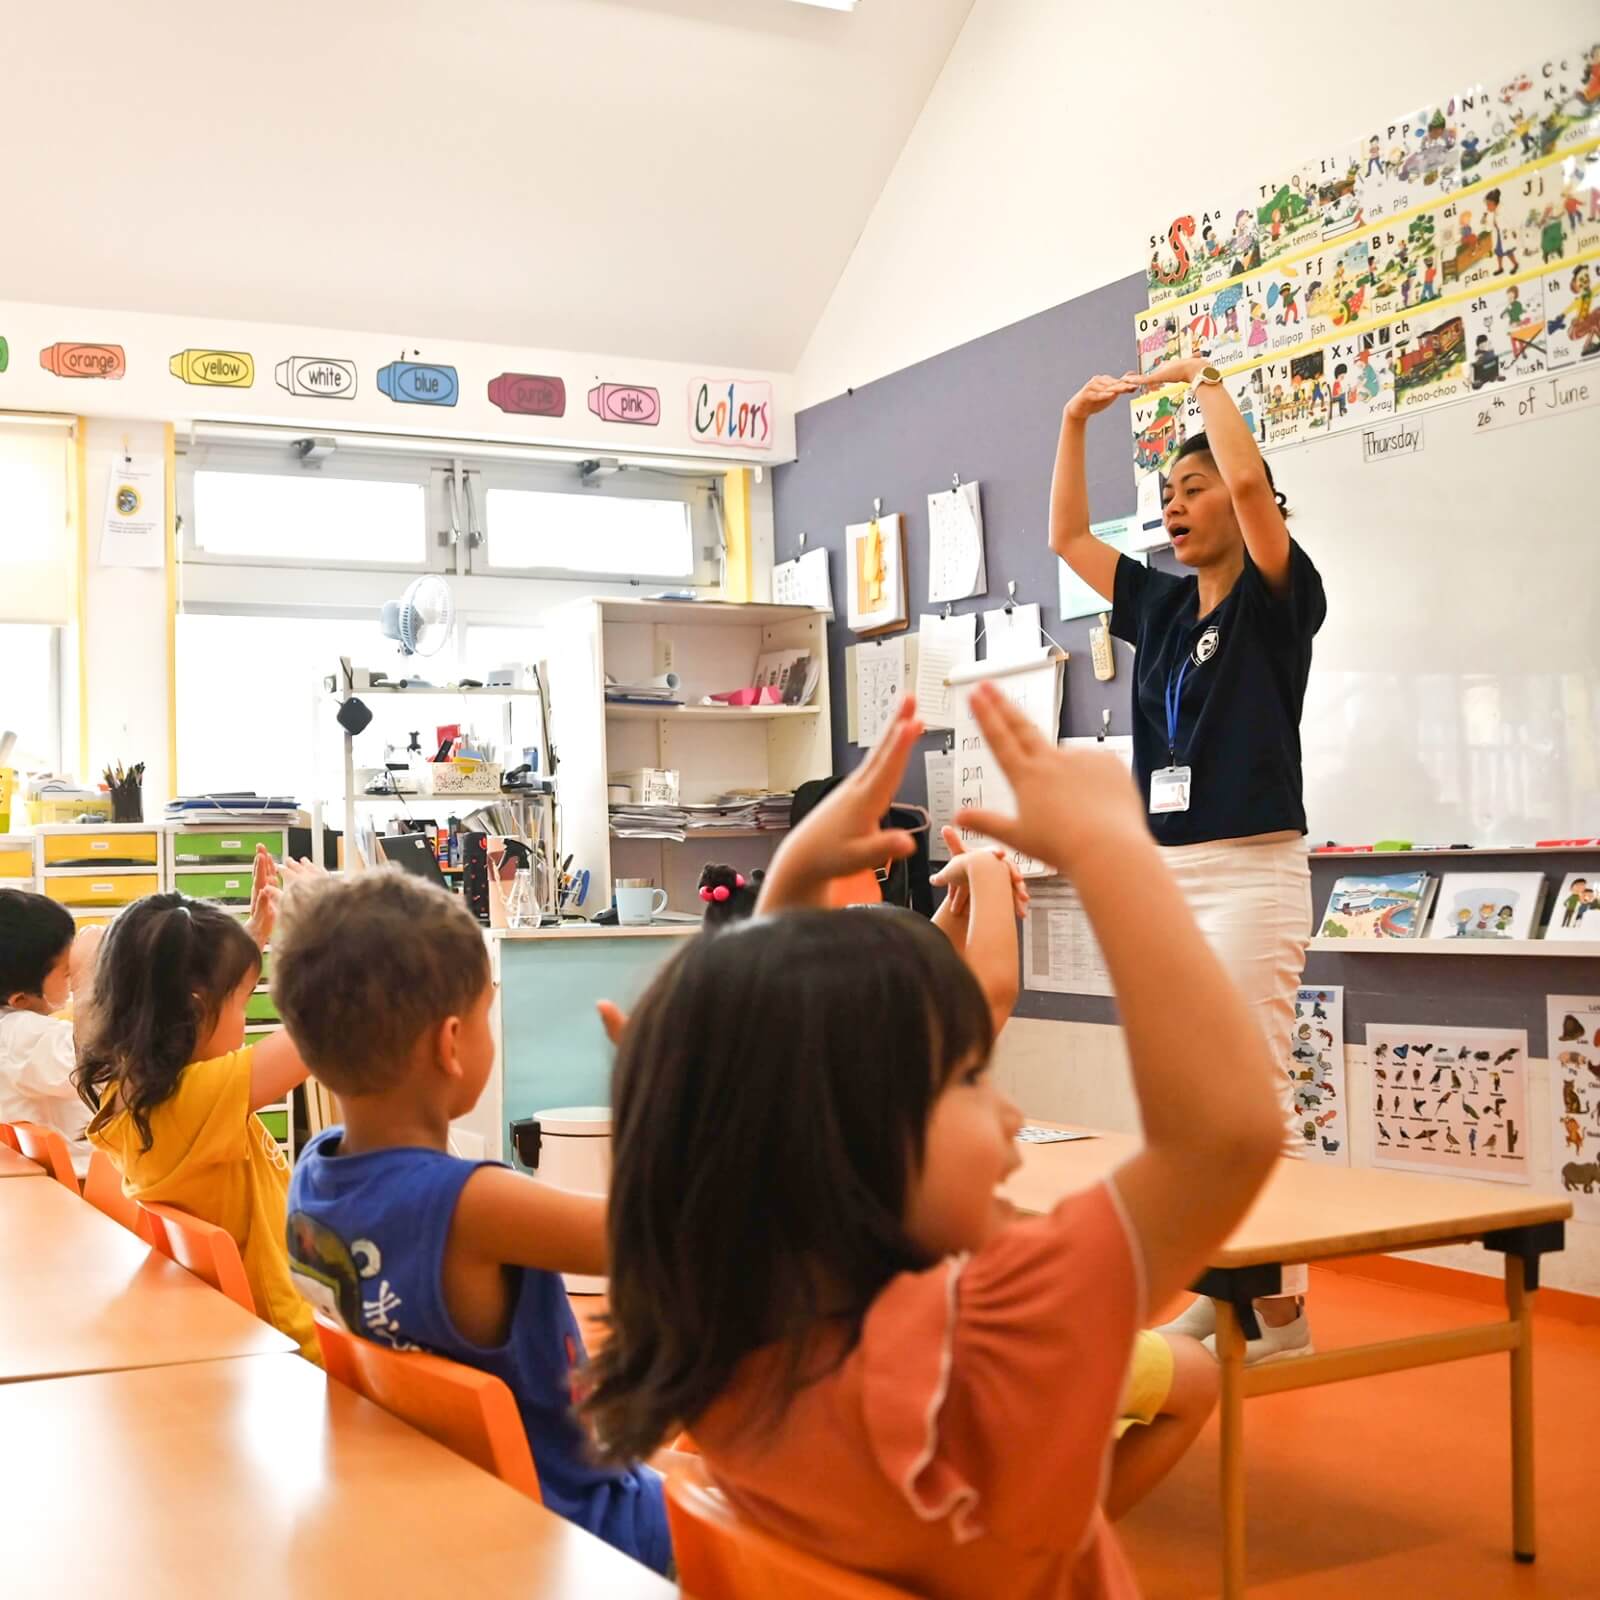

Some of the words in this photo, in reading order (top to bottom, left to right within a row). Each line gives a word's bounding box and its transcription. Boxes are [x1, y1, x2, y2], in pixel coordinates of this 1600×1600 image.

[1542, 62, 1552, 78] C
[1544, 88, 1554, 101] K
[1462, 97, 1474, 112] N
[1481, 94, 1489, 105] n
[1387, 126, 1396, 140] P
[1491, 155, 1508, 169] net
[1259, 186, 1267, 198] T
[1272, 185, 1277, 194] t
[1523, 181, 1532, 197] J
[1538, 176, 1544, 197] j
[1393, 195, 1408, 210] pig
[1202, 213, 1210, 225] A
[1214, 210, 1221, 219] a
[1369, 204, 1383, 217] ink
[1444, 203, 1457, 218] ai
[1150, 235, 1157, 248] S
[1159, 235, 1165, 244] s
[1292, 230, 1318, 246] tennis
[1372, 236, 1381, 249] B
[1386, 232, 1394, 244] b
[1577, 234, 1599, 252] jam
[1306, 261, 1313, 275] F
[1316, 257, 1324, 274] f
[1205, 269, 1223, 282] ants
[1464, 268, 1489, 288] pain
[1246, 285, 1254, 297] L
[1549, 280, 1560, 292] th
[1151, 290, 1172, 304] snake
[1189, 303, 1198, 316] U
[1203, 303, 1210, 312] u
[1376, 300, 1392, 314] bat
[1471, 298, 1487, 312] sh
[1140, 319, 1148, 332] O
[1152, 319, 1159, 327] o
[1311, 322, 1326, 339] fish
[1395, 320, 1409, 335] ch
[1272, 332, 1304, 349] lollipop
[1331, 345, 1341, 360] X
[1346, 345, 1353, 355] x
[1553, 345, 1569, 358] this
[68, 352, 114, 373] orange
[202, 360, 240, 379] yellow
[1516, 360, 1544, 377] hush
[308, 368, 342, 387] white
[1268, 365, 1276, 378] Y
[1281, 366, 1288, 379] y
[414, 367, 439, 394] blue
[1406, 384, 1457, 406] choo-choo
[1518, 386, 1535, 416] of
[1546, 379, 1589, 408] June
[620, 395, 644, 415] pink
[695, 383, 769, 441] Colors
[1370, 400, 1392, 414] x-ray
[1136, 410, 1144, 422] V
[1147, 411, 1152, 419] v
[1269, 424, 1298, 442] yogurt
[1363, 424, 1420, 456] Thursday
